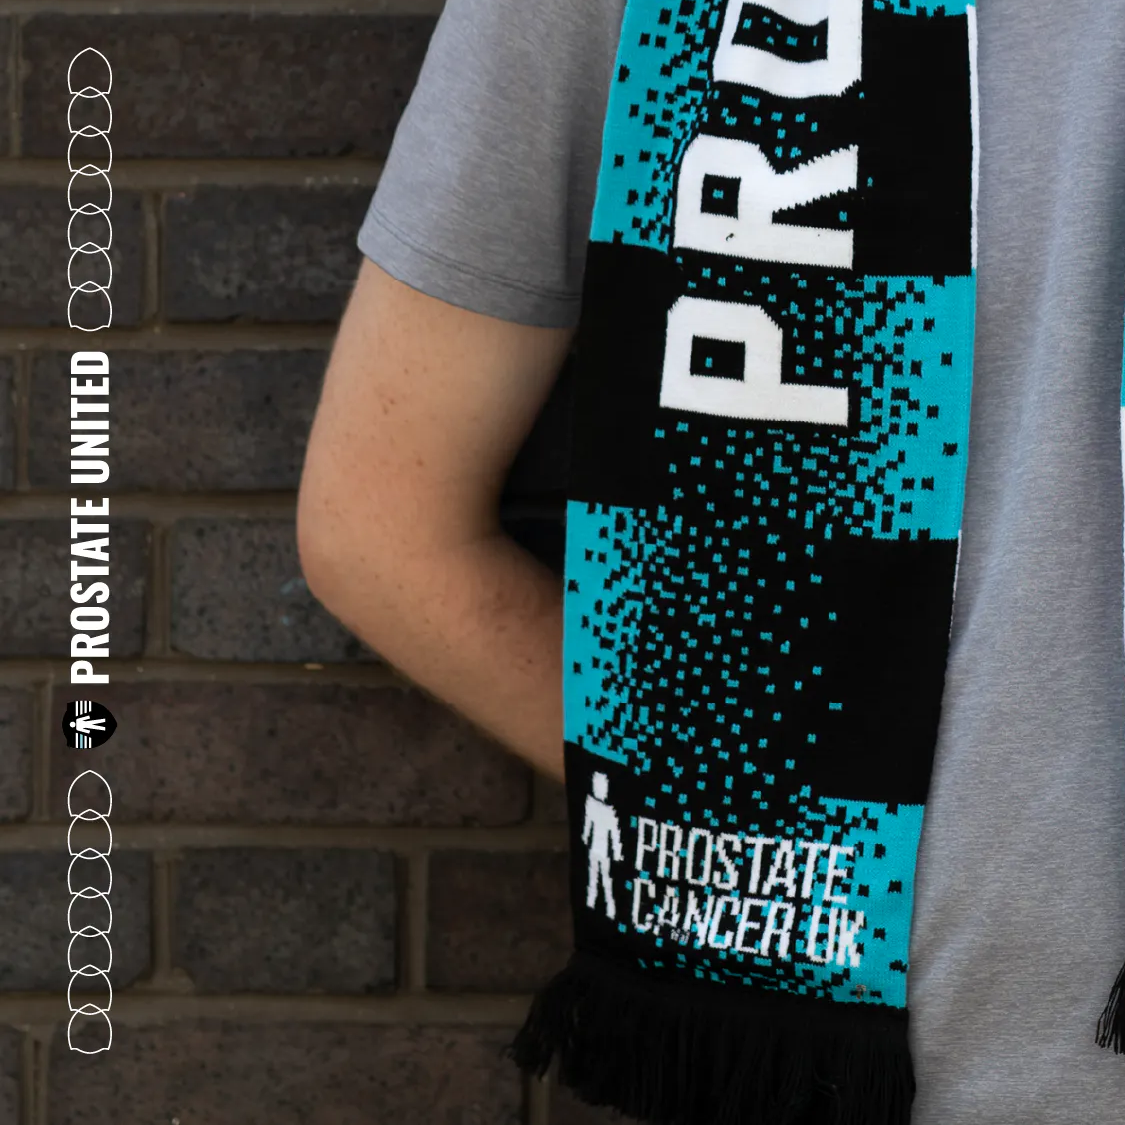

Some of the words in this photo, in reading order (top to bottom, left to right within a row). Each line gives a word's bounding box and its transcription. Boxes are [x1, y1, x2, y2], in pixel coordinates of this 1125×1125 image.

[635, 816, 855, 904] PROSTATE
[631, 877, 796, 959] CANCER
[805, 905, 865, 967] UK
